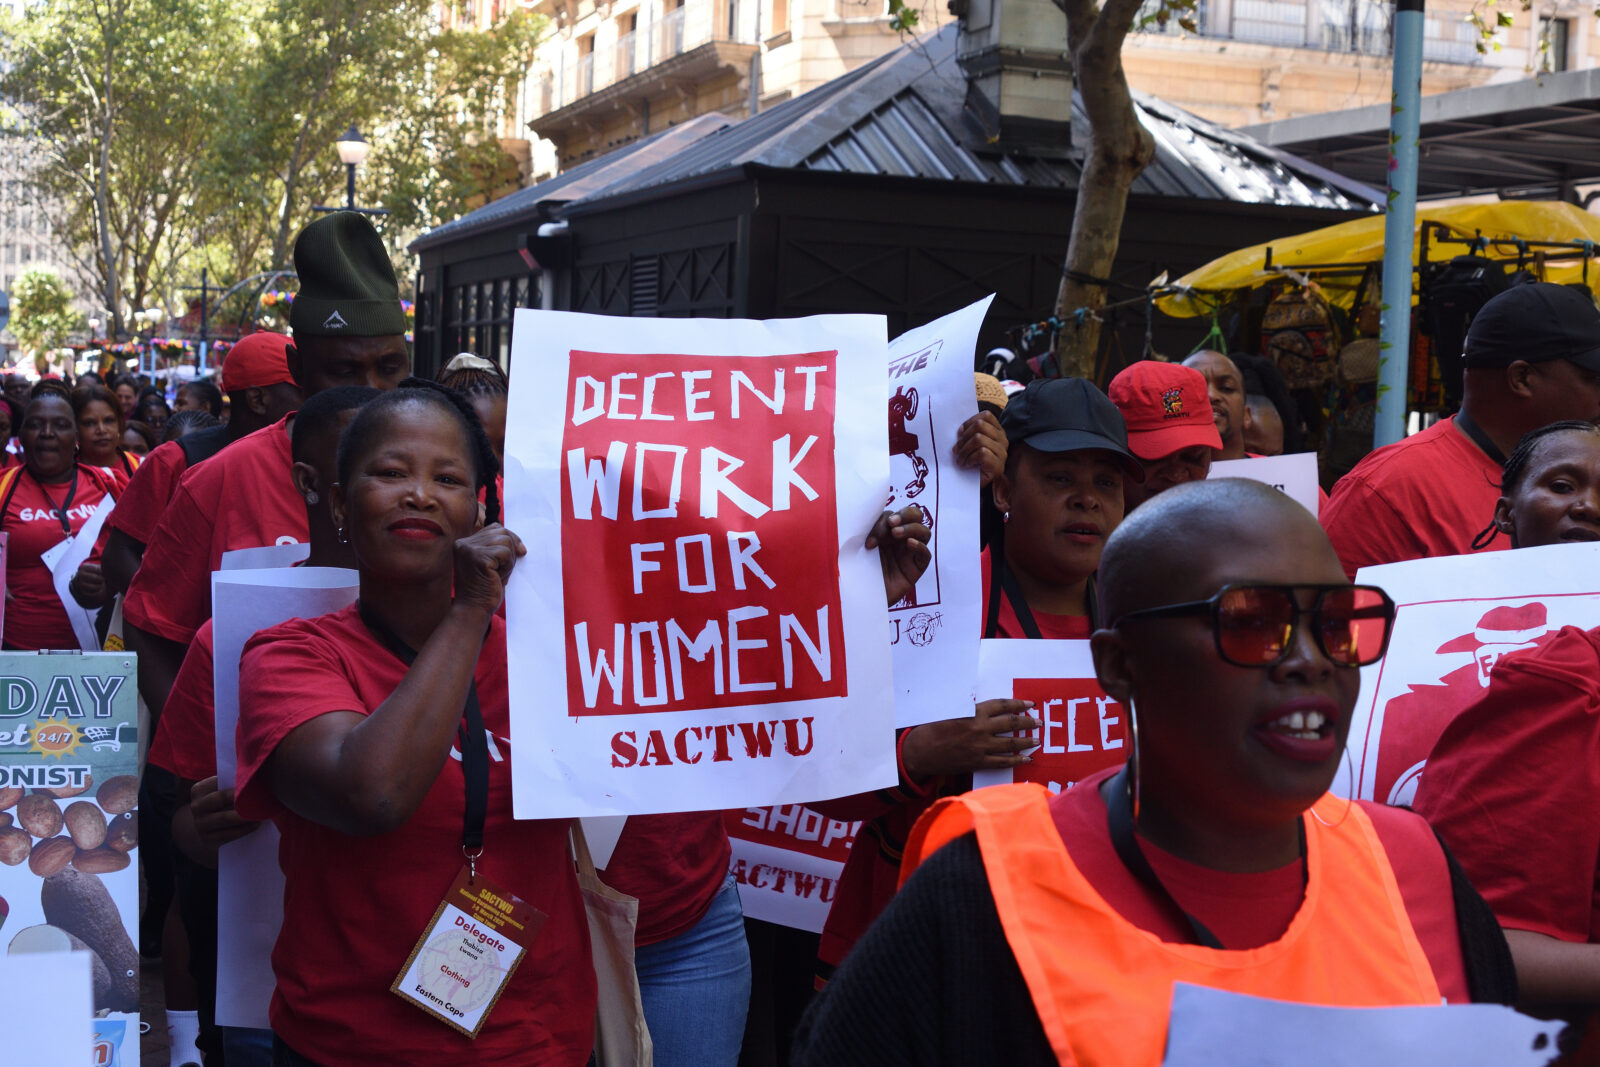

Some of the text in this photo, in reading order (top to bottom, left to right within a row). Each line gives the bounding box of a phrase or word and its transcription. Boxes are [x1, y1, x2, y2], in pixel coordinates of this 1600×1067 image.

[572, 365, 828, 426] DECENT
[567, 433, 819, 521] WORK
[630, 530, 777, 595] FOR
[573, 604, 832, 709] WOMEN
[37, 732, 72, 744] 24/7
[610, 716, 815, 768] SACTWU
[480, 888, 514, 914] SACTWU
[454, 915, 505, 952] Delegate
[440, 964, 471, 988] Clothing
[415, 984, 465, 1019] Eastern Cape
